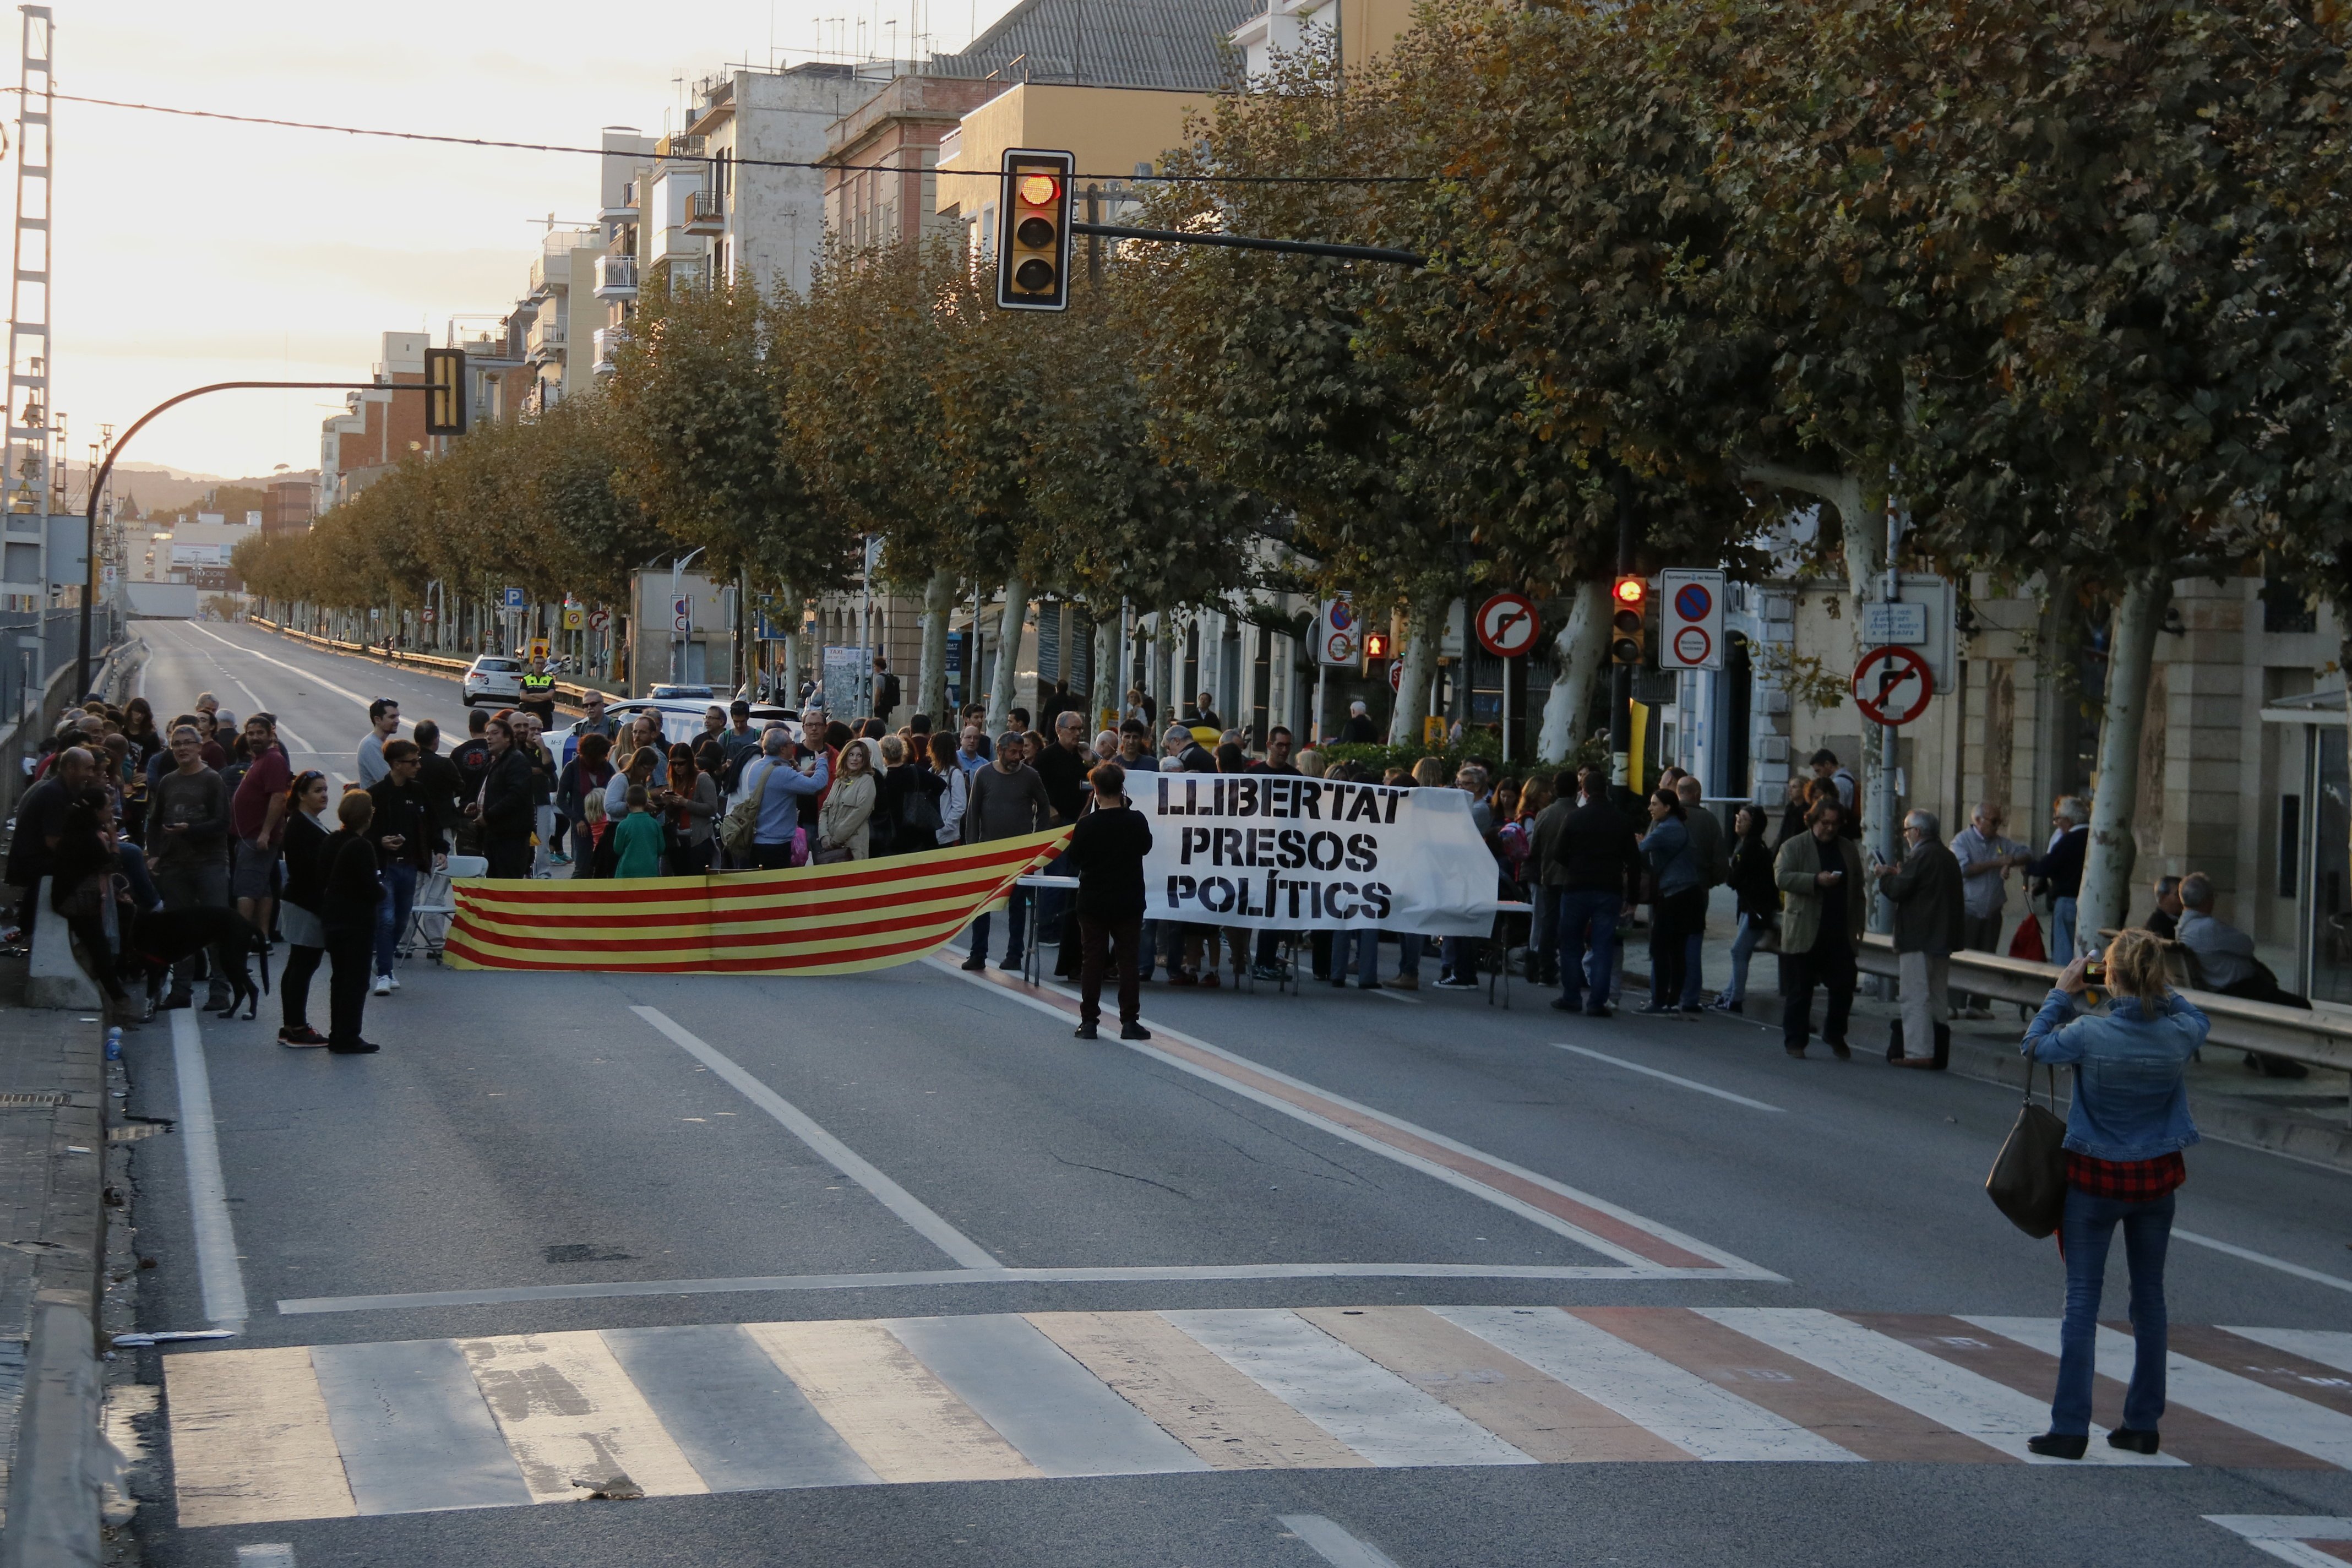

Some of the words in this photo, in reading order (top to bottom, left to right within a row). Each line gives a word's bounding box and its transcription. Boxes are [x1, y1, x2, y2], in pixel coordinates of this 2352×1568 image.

[508, 591, 520, 604] P
[1157, 777, 1409, 824] LLIBERTAT
[1180, 826, 1378, 873] PRESOS
[1167, 869, 1392, 919] POLÍTICS
